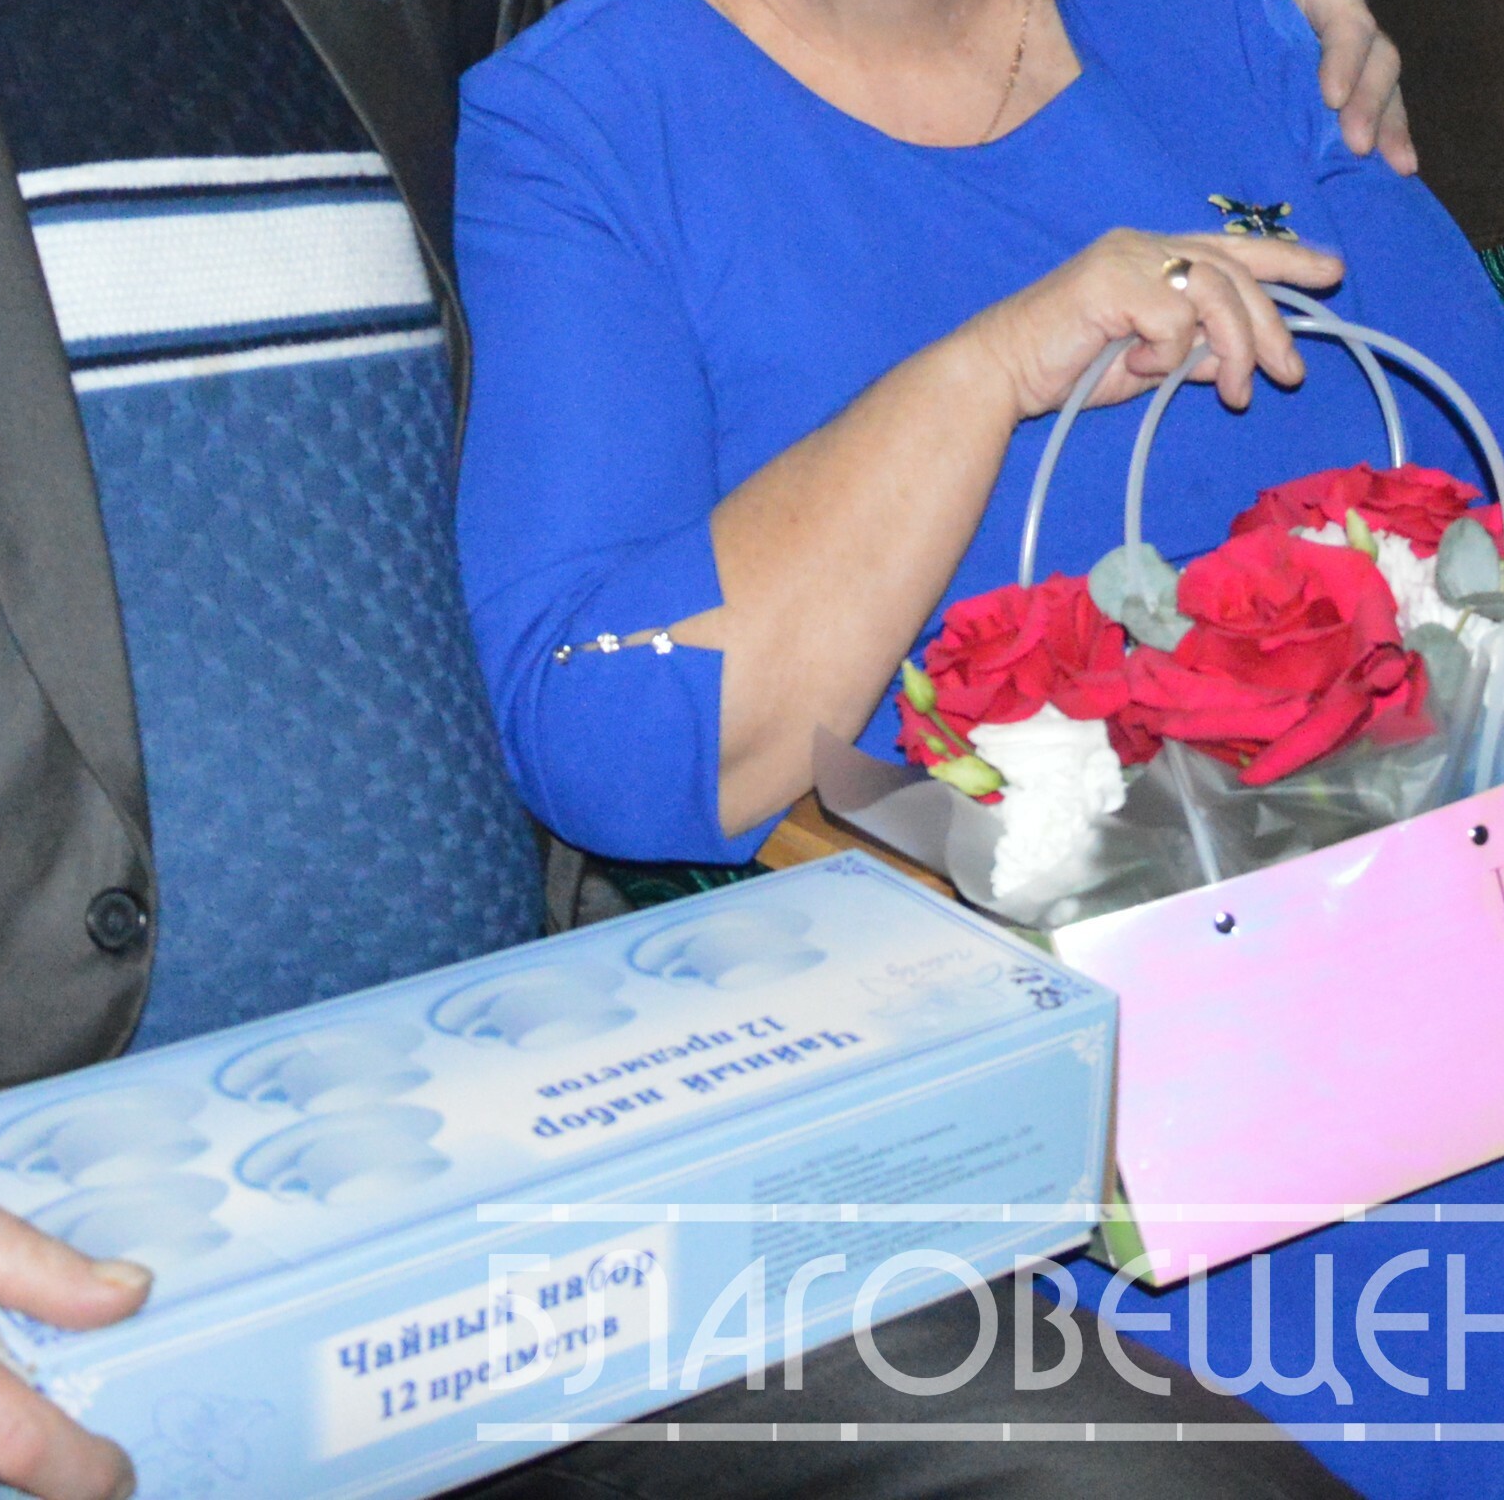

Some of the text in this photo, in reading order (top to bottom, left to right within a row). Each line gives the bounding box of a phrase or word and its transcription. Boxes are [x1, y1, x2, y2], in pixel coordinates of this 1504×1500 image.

[531, 1029, 864, 1139] Чайный набор
[536, 1015, 786, 1100] 12 предметов
[337, 1249, 658, 1378] Чайный набор
[380, 1379, 418, 1420] 12
